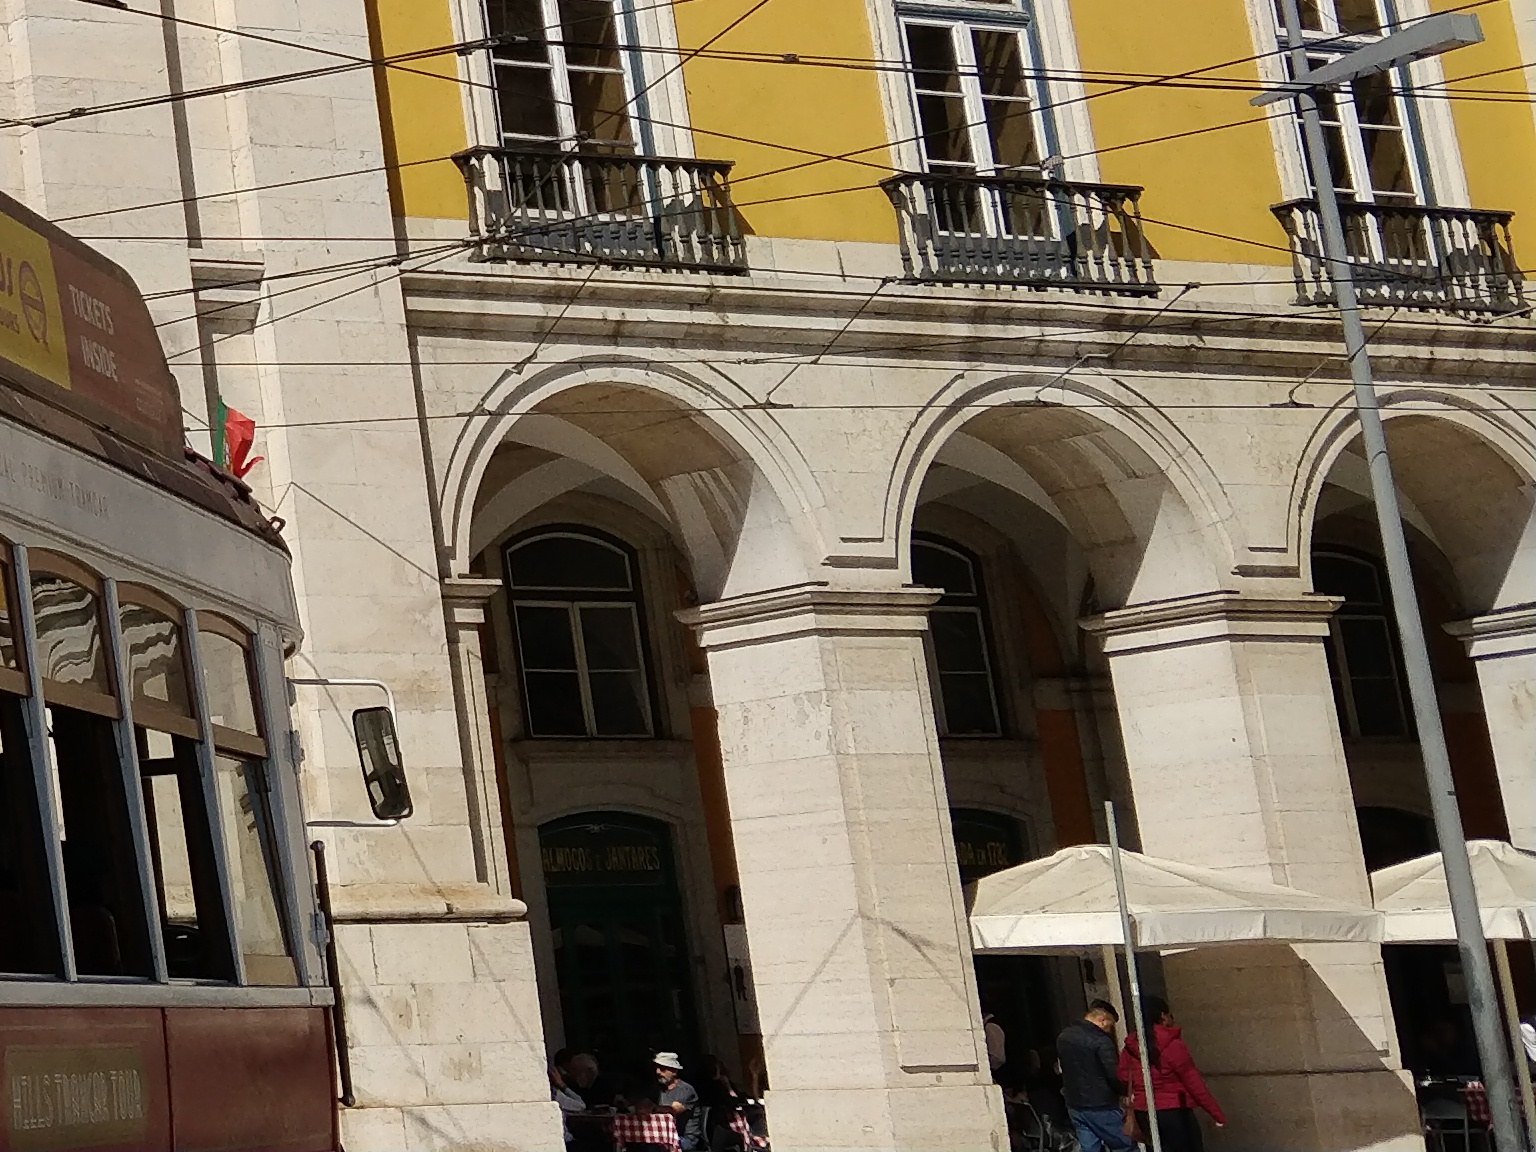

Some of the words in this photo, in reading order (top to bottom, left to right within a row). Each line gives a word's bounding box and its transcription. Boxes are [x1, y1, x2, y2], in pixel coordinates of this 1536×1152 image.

[67, 283, 115, 336] TICKETS
[79, 334, 119, 382] INSIDE
[605, 846, 661, 872] JANTARES
[11, 1074, 54, 1130] HILLS
[109, 1069, 143, 1121] TOUR
